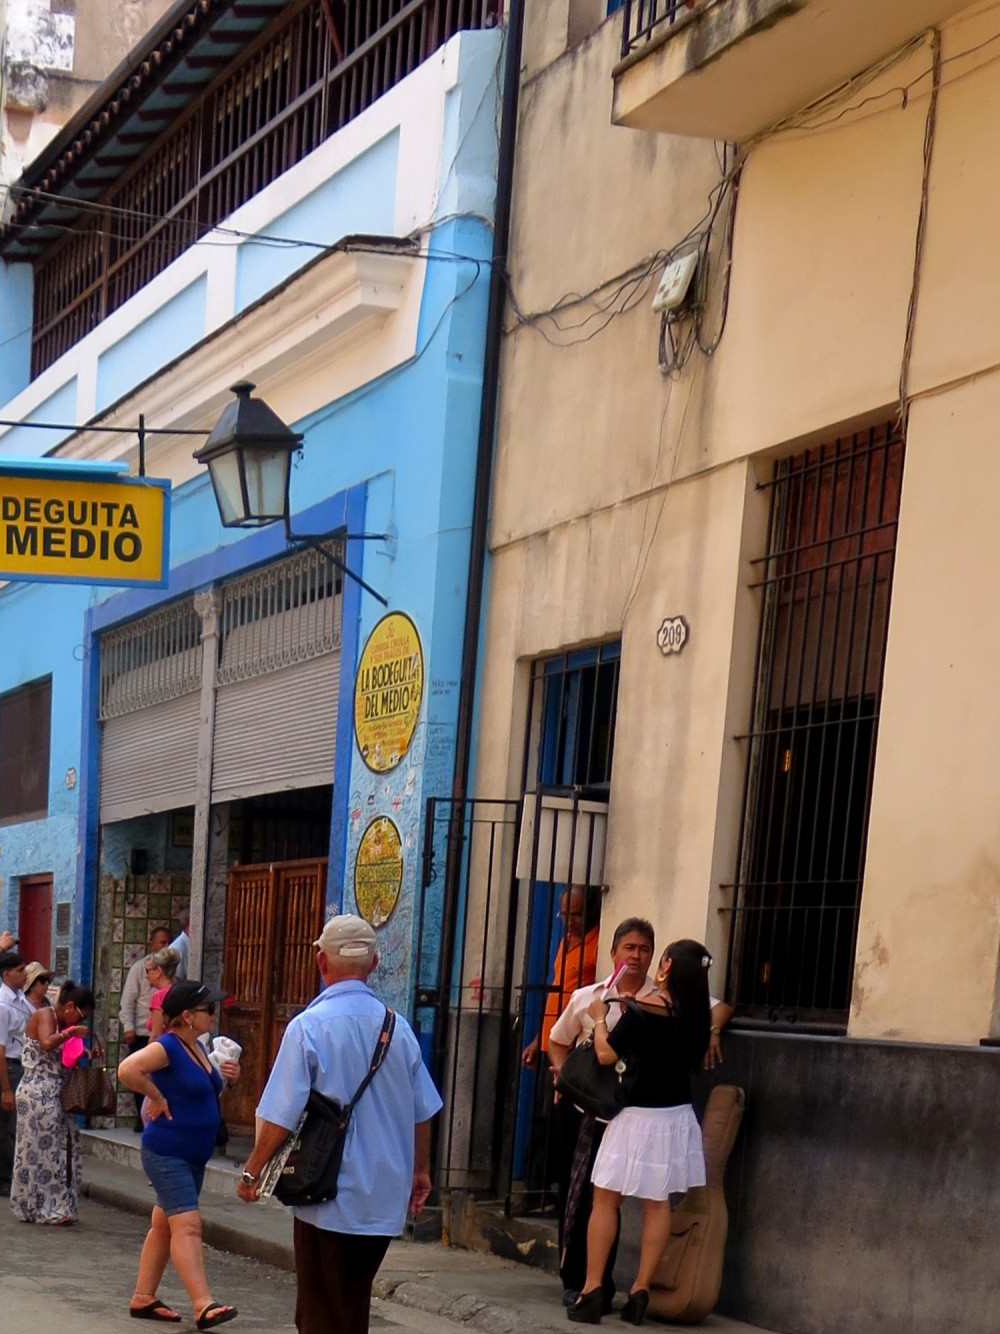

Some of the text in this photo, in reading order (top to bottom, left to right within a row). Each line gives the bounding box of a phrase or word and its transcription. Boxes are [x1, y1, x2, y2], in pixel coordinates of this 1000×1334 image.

[5, 524, 143, 562] MEDIO
[662, 624, 682, 647] 209
[361, 668, 370, 692] LA
[365, 693, 379, 719] DEL
[381, 686, 410, 716] MEDIO
